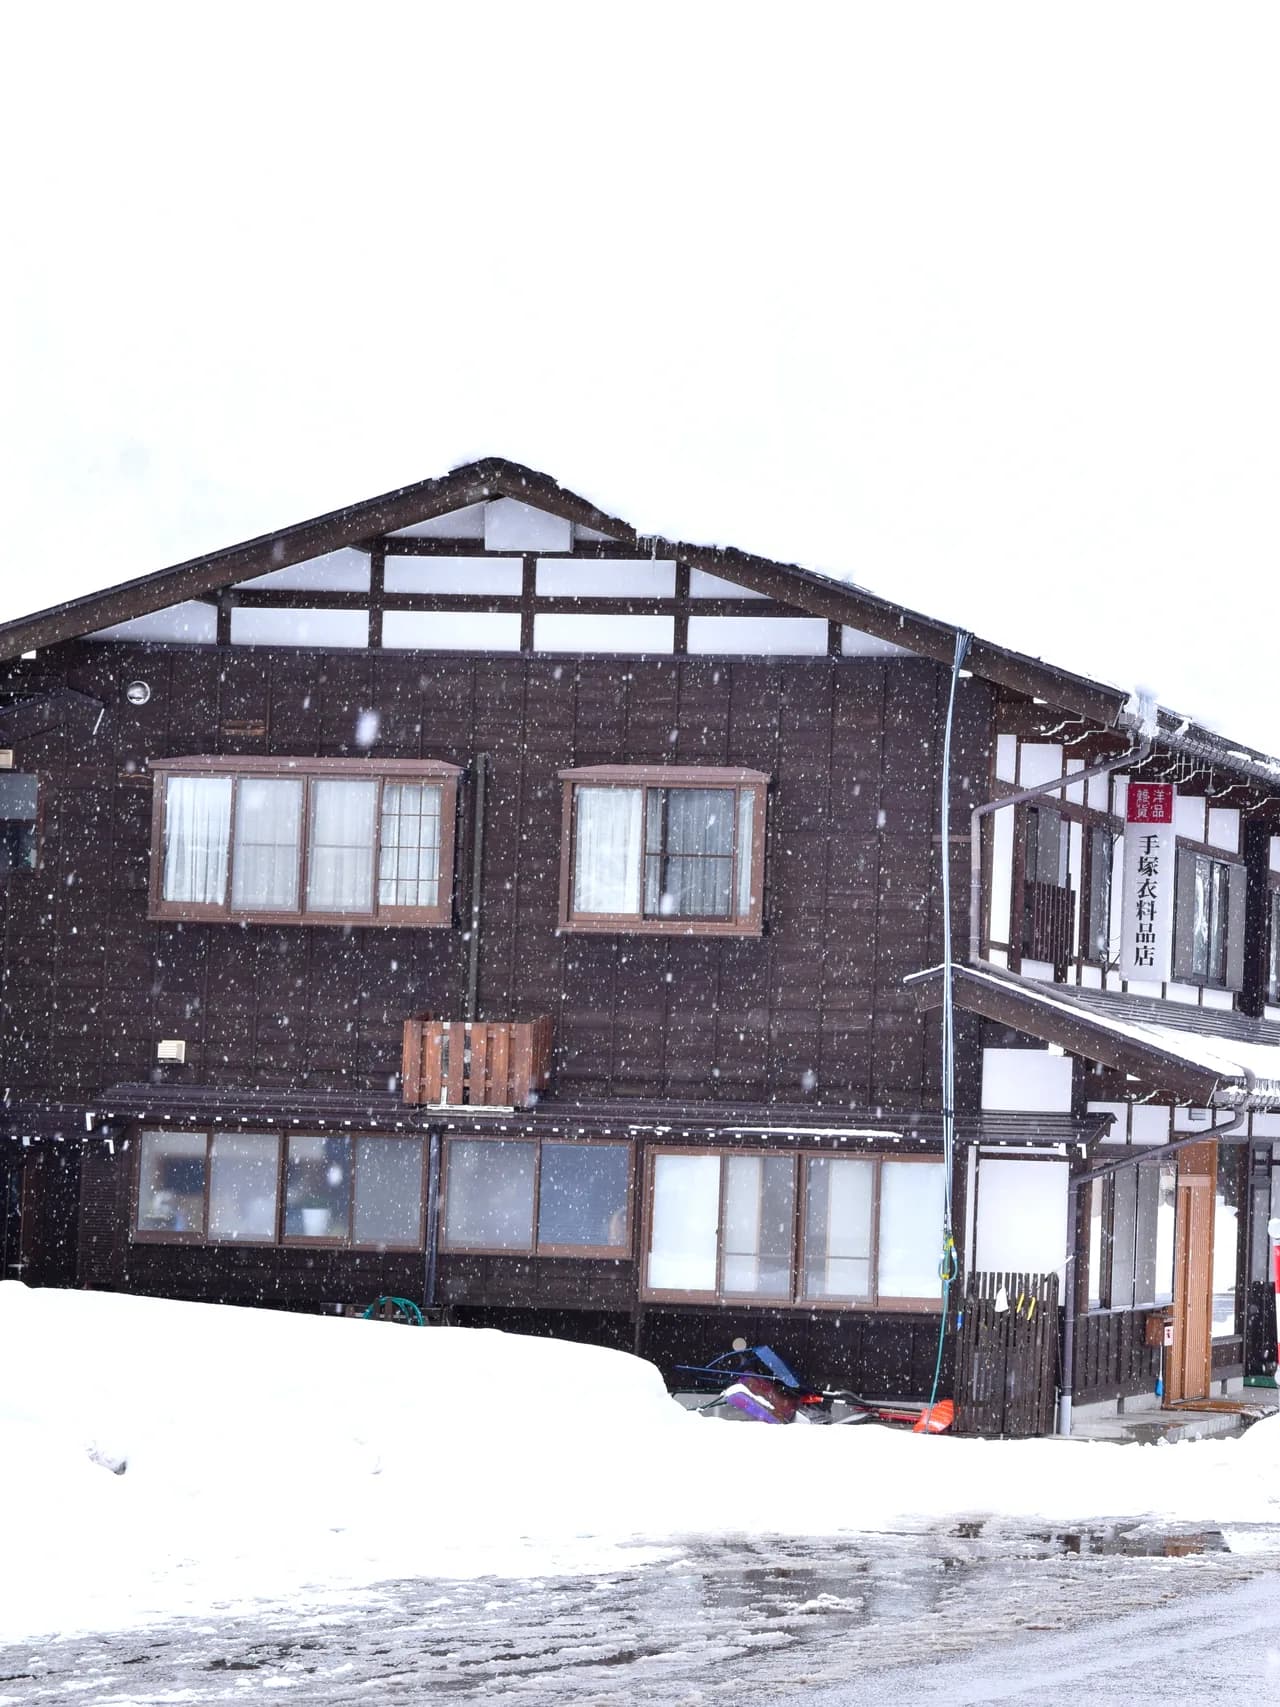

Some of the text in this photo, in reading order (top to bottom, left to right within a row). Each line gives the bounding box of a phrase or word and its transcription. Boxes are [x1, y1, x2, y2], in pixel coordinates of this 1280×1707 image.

[1152, 789, 1165, 818] 洋品
[1134, 834, 1160, 967] 手塚衣料品店
